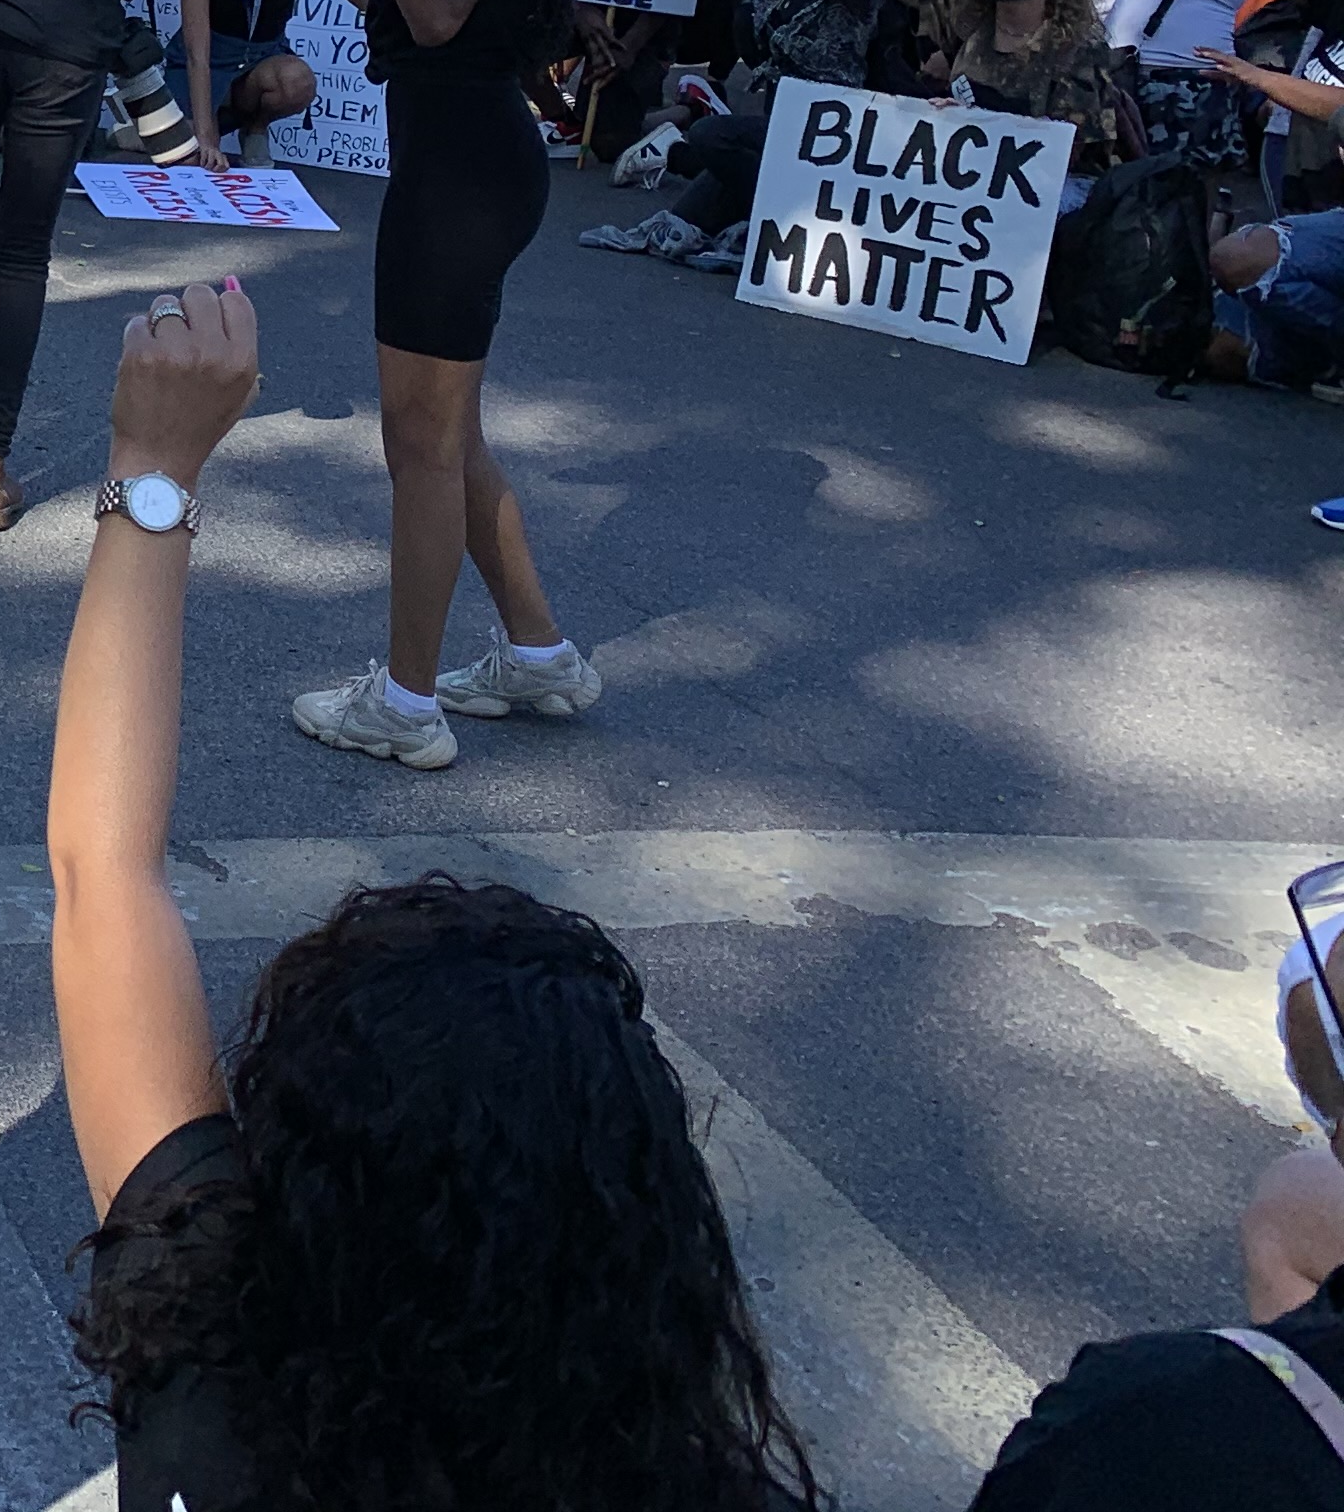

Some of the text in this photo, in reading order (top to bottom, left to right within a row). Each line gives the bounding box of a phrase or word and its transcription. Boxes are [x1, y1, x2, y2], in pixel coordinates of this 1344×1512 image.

[269, 126, 390, 151] NOT A PROBLE
[279, 143, 309, 158] YOU
[798, 99, 1046, 208] BLACK
[122, 170, 200, 222] RACISM
[204, 173, 295, 226] RACISM
[814, 179, 994, 263] LIVES
[749, 218, 1015, 345] MATTER
